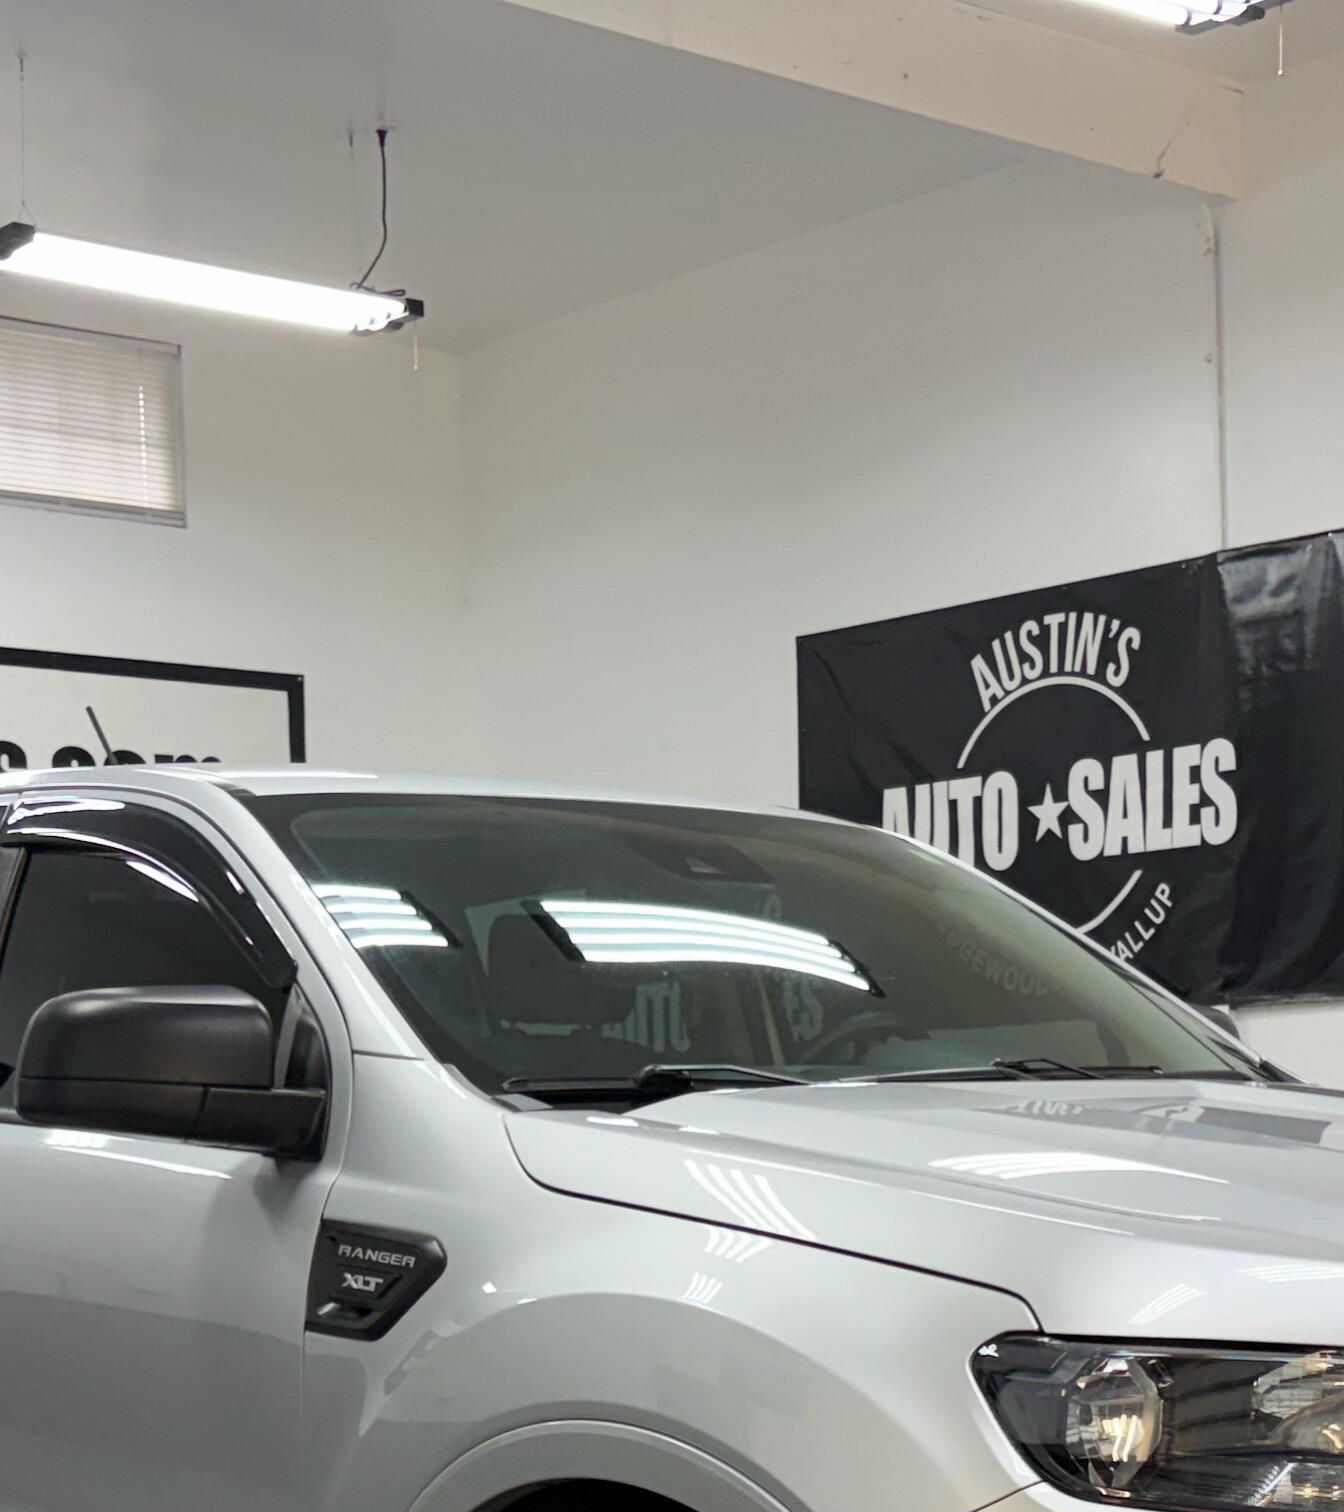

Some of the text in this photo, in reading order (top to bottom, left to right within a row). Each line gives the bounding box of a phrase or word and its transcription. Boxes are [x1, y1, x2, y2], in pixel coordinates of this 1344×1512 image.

[969, 610, 1142, 713] AUSTIN'S
[1067, 737, 1238, 861] SALES
[1110, 882, 1173, 961] ALLUP
[338, 1244, 416, 1269] RANGER
[342, 1272, 384, 1292] XLT
